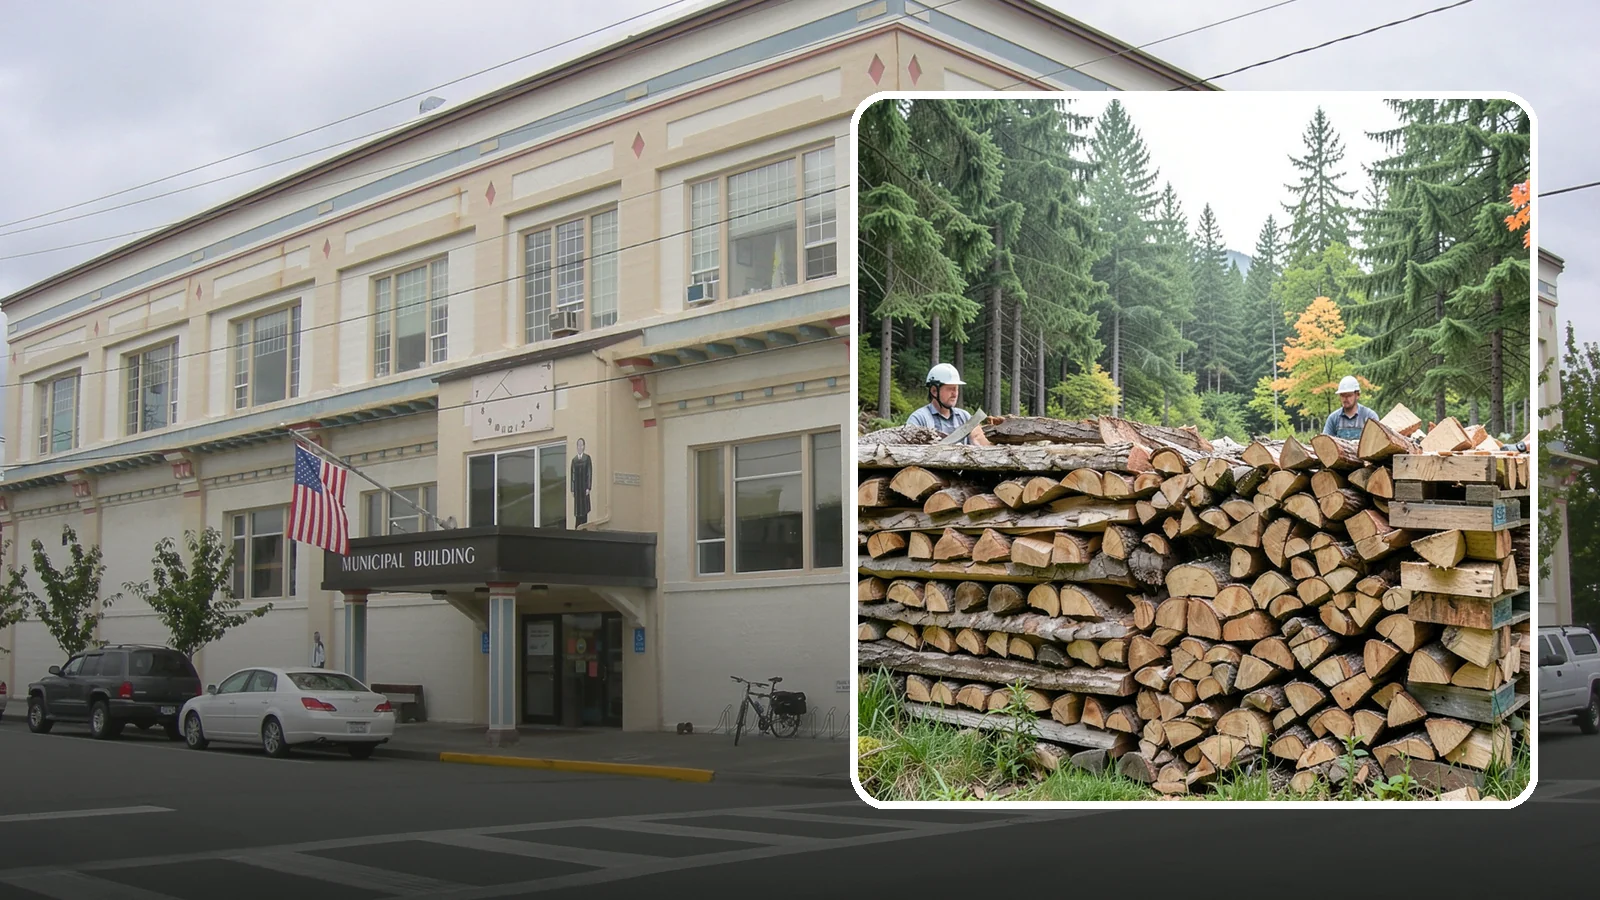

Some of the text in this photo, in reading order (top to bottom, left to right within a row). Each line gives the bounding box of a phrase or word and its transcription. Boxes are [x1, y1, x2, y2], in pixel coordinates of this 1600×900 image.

[480, 407, 485, 415] 8
[487, 417, 492, 426] 9
[494, 423, 500, 432] 10
[501, 425, 506, 434] 11
[507, 425, 513, 433] 12
[521, 420, 525, 428] 2
[528, 413, 533, 422] 3
[342, 546, 475, 571] MUNICIPAL BUILDING
